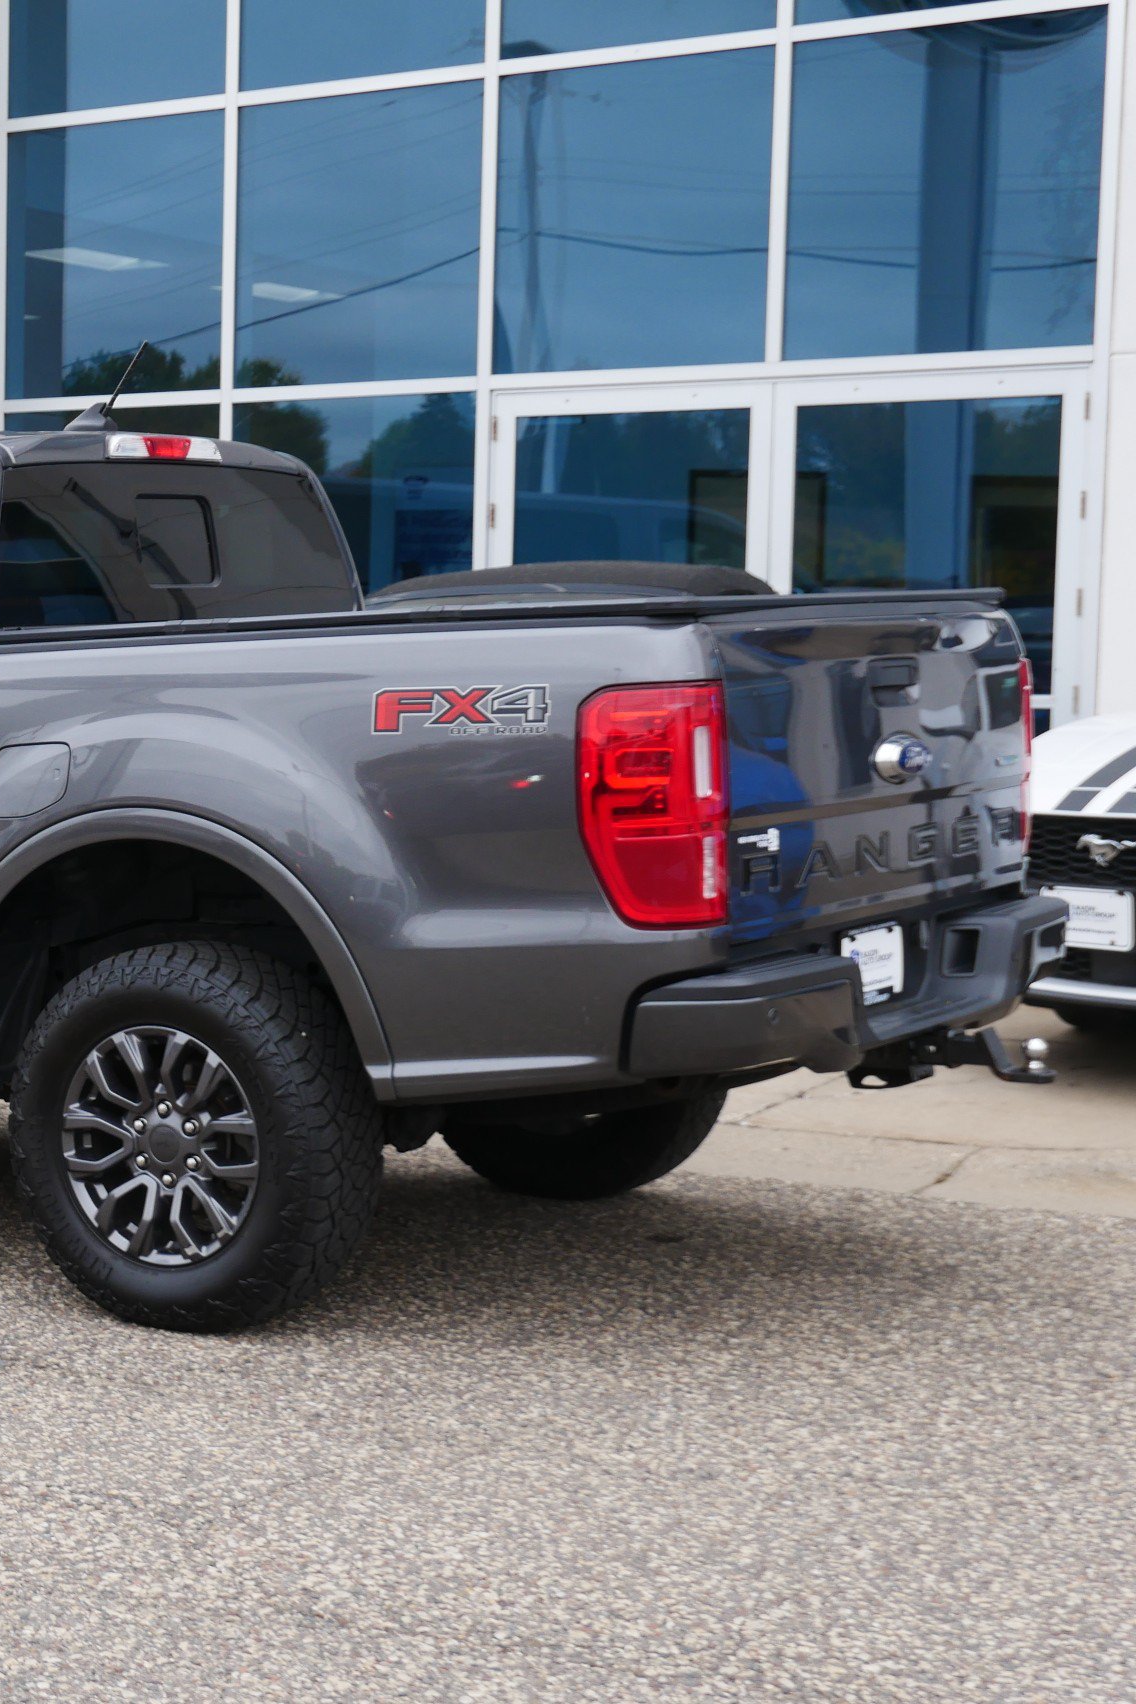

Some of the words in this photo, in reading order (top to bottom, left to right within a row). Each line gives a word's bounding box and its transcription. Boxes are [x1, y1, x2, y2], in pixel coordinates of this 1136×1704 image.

[371, 684, 552, 735] FX4
[449, 726, 490, 735] OFF
[494, 725, 548, 735] ROAD
[739, 805, 1016, 896] RANGER
